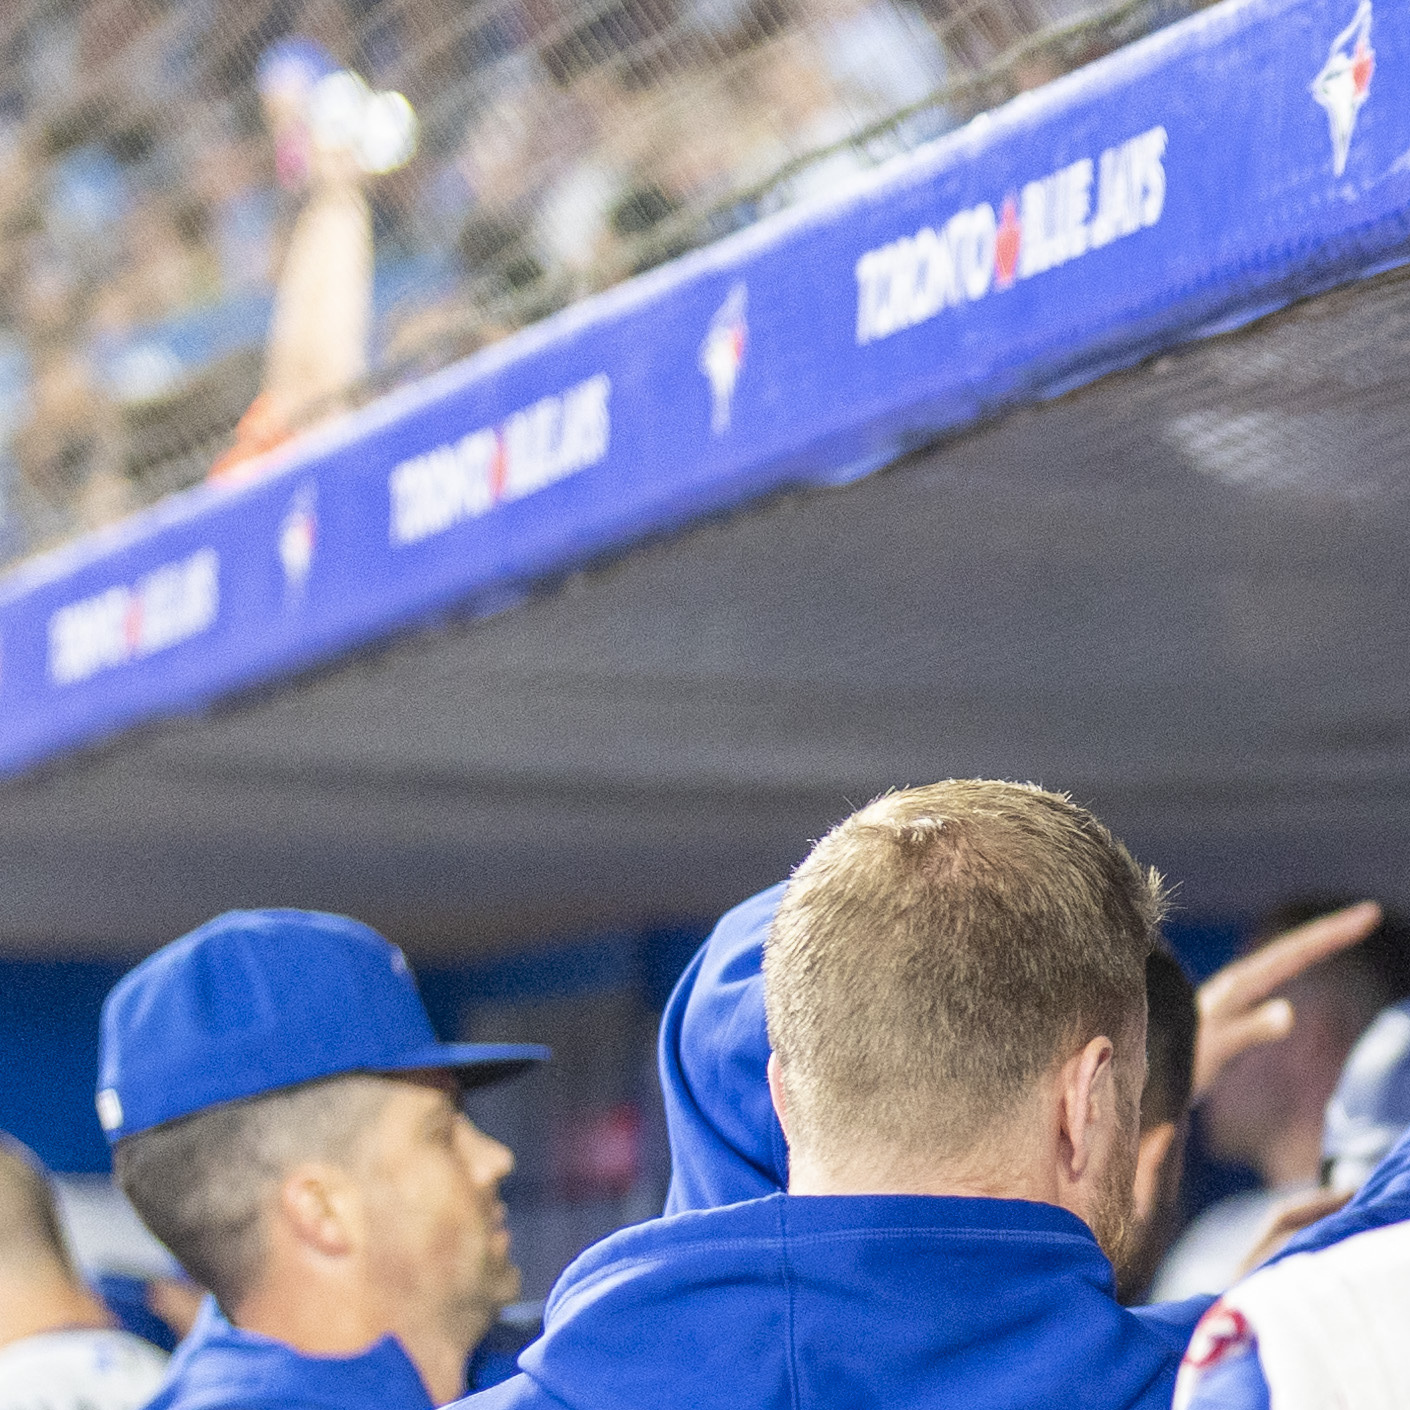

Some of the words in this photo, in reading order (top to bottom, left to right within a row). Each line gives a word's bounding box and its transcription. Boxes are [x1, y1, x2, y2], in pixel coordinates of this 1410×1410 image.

[855, 202, 998, 346] TORONTO
[1020, 157, 1095, 280] BLUE
[1090, 124, 1169, 250] JAYS
